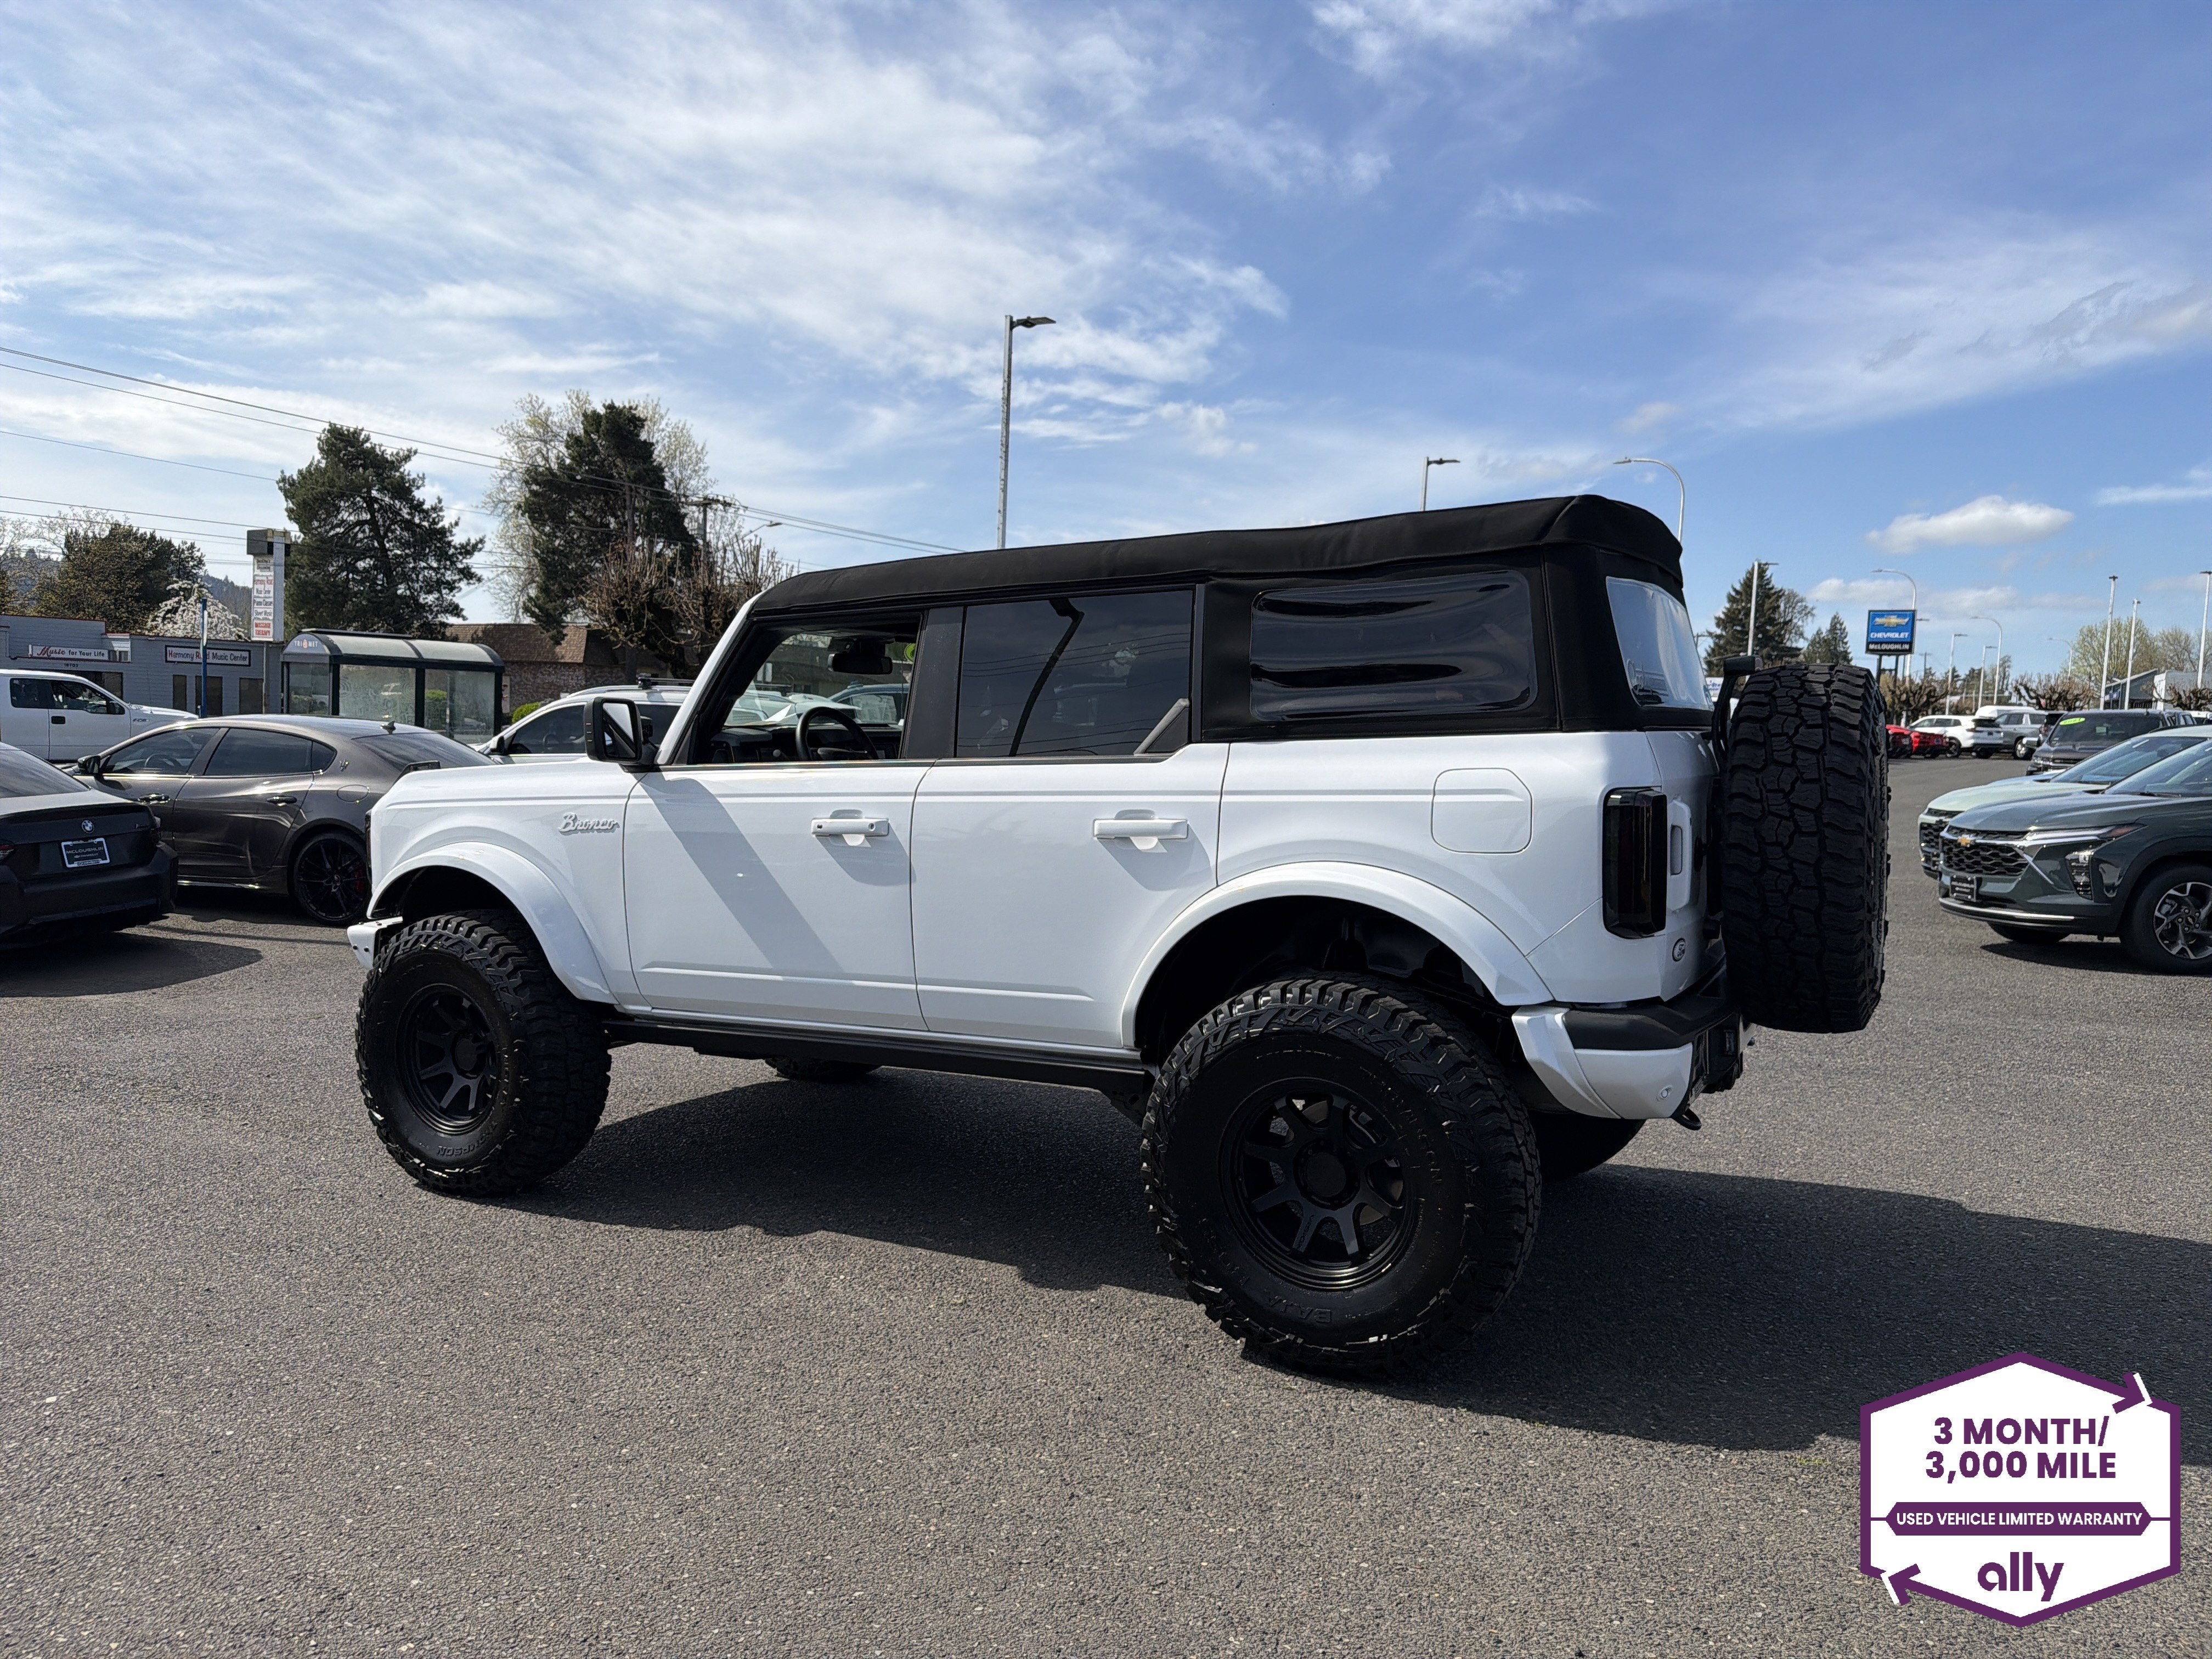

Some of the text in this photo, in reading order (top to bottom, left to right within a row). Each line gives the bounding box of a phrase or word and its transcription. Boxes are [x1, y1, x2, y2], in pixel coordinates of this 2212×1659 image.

[37, 646, 66, 657] Music
[168, 650, 194, 661] Harmony
[212, 652, 228, 661] Music
[230, 653, 247, 662] Center
[558, 812, 620, 833] Bronco
